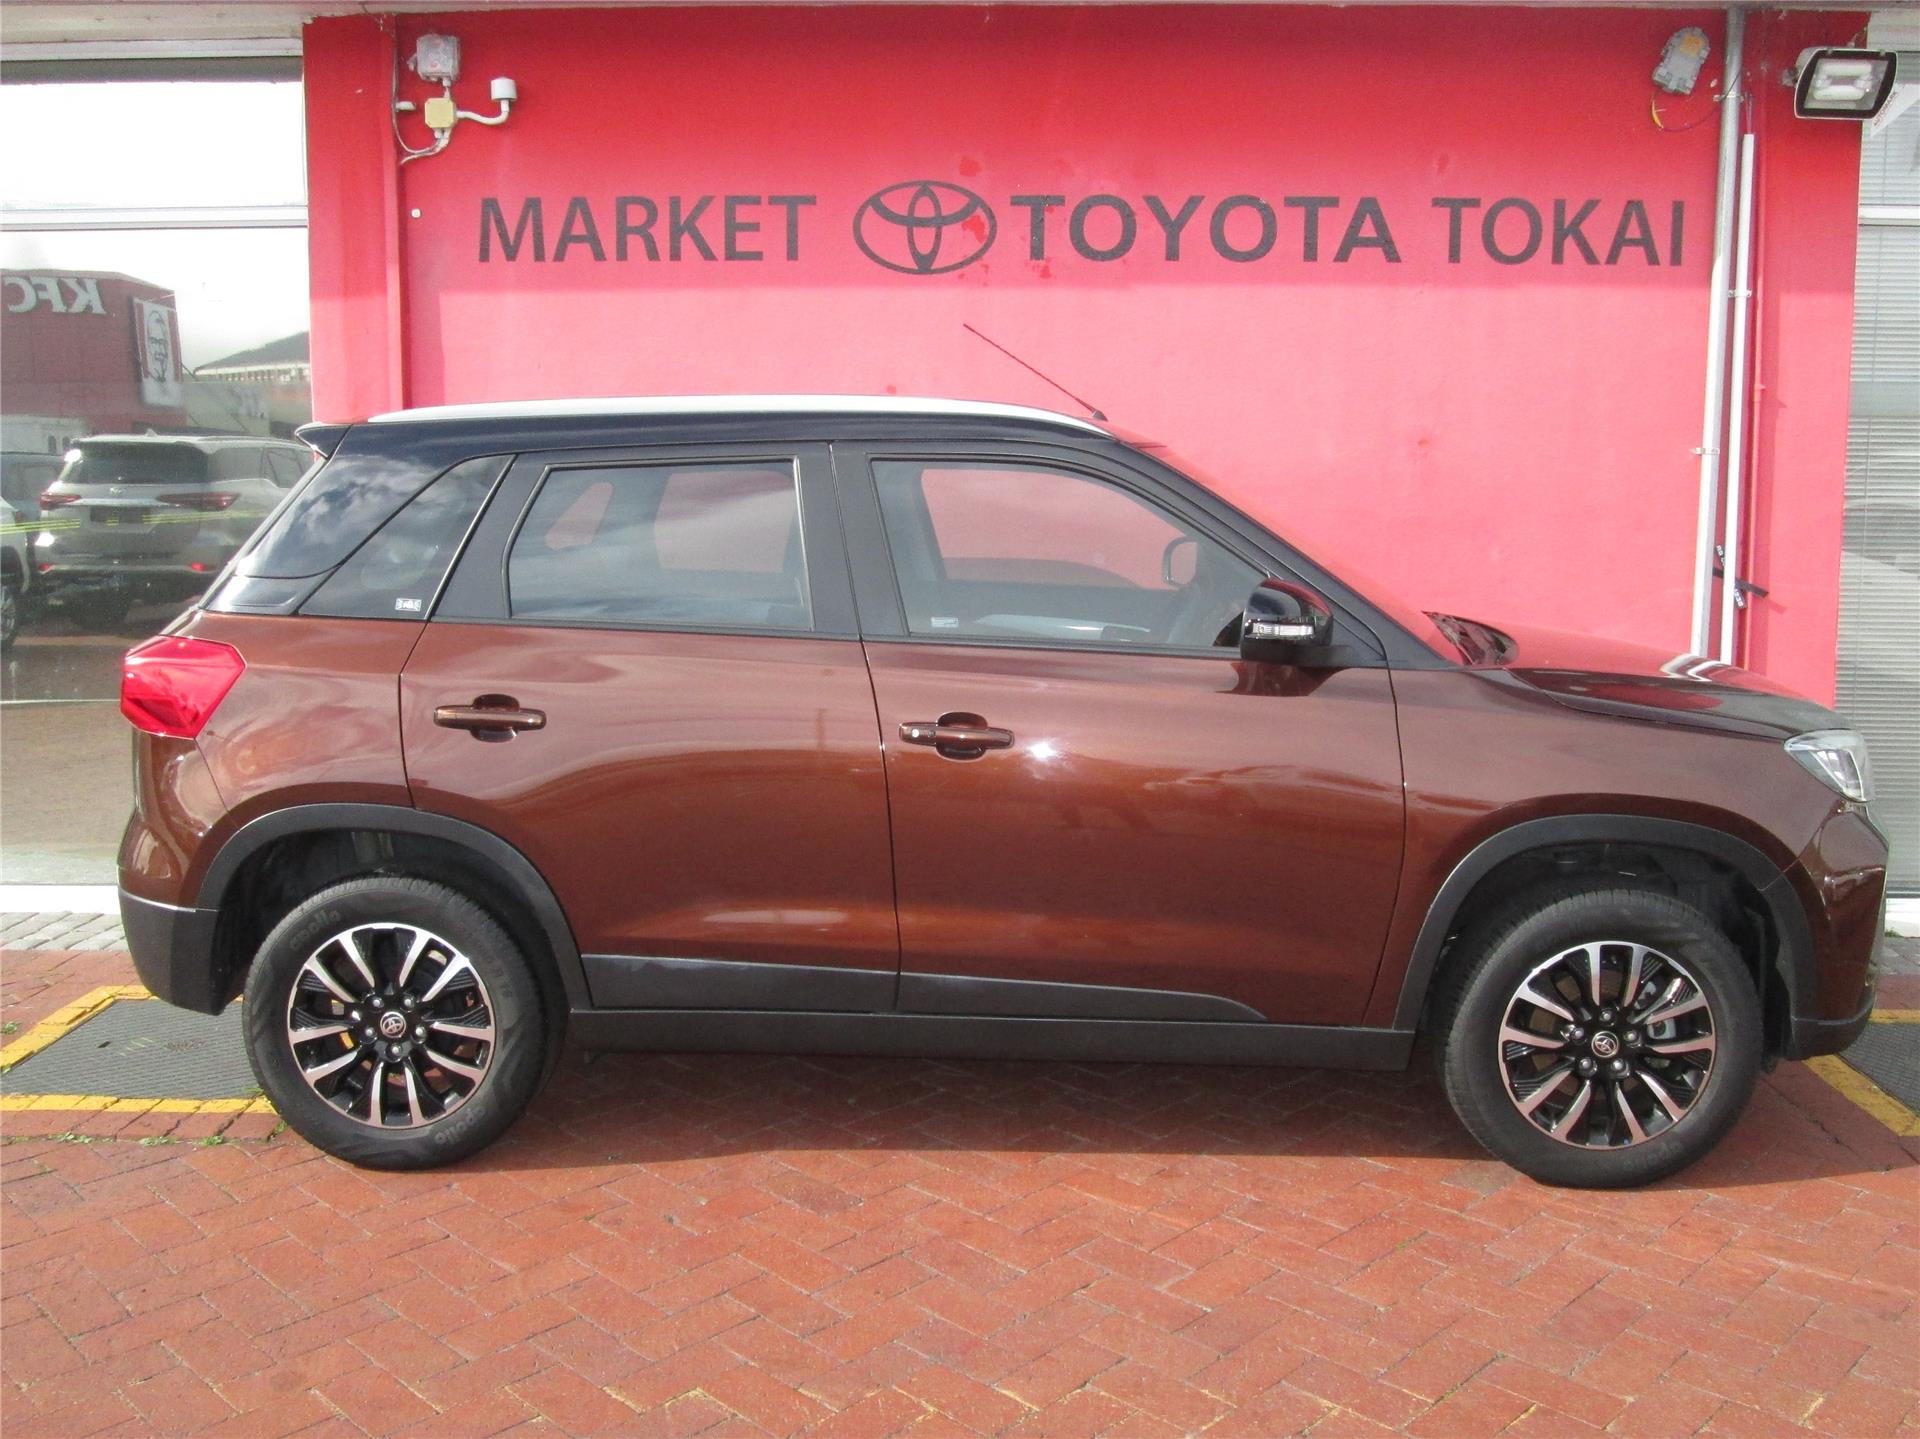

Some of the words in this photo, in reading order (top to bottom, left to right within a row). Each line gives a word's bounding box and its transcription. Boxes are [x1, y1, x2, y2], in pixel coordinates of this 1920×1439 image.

[478, 194, 817, 263] MARKET
[1011, 194, 1402, 264] TOYOTA
[1432, 196, 1685, 267] TOKAI
